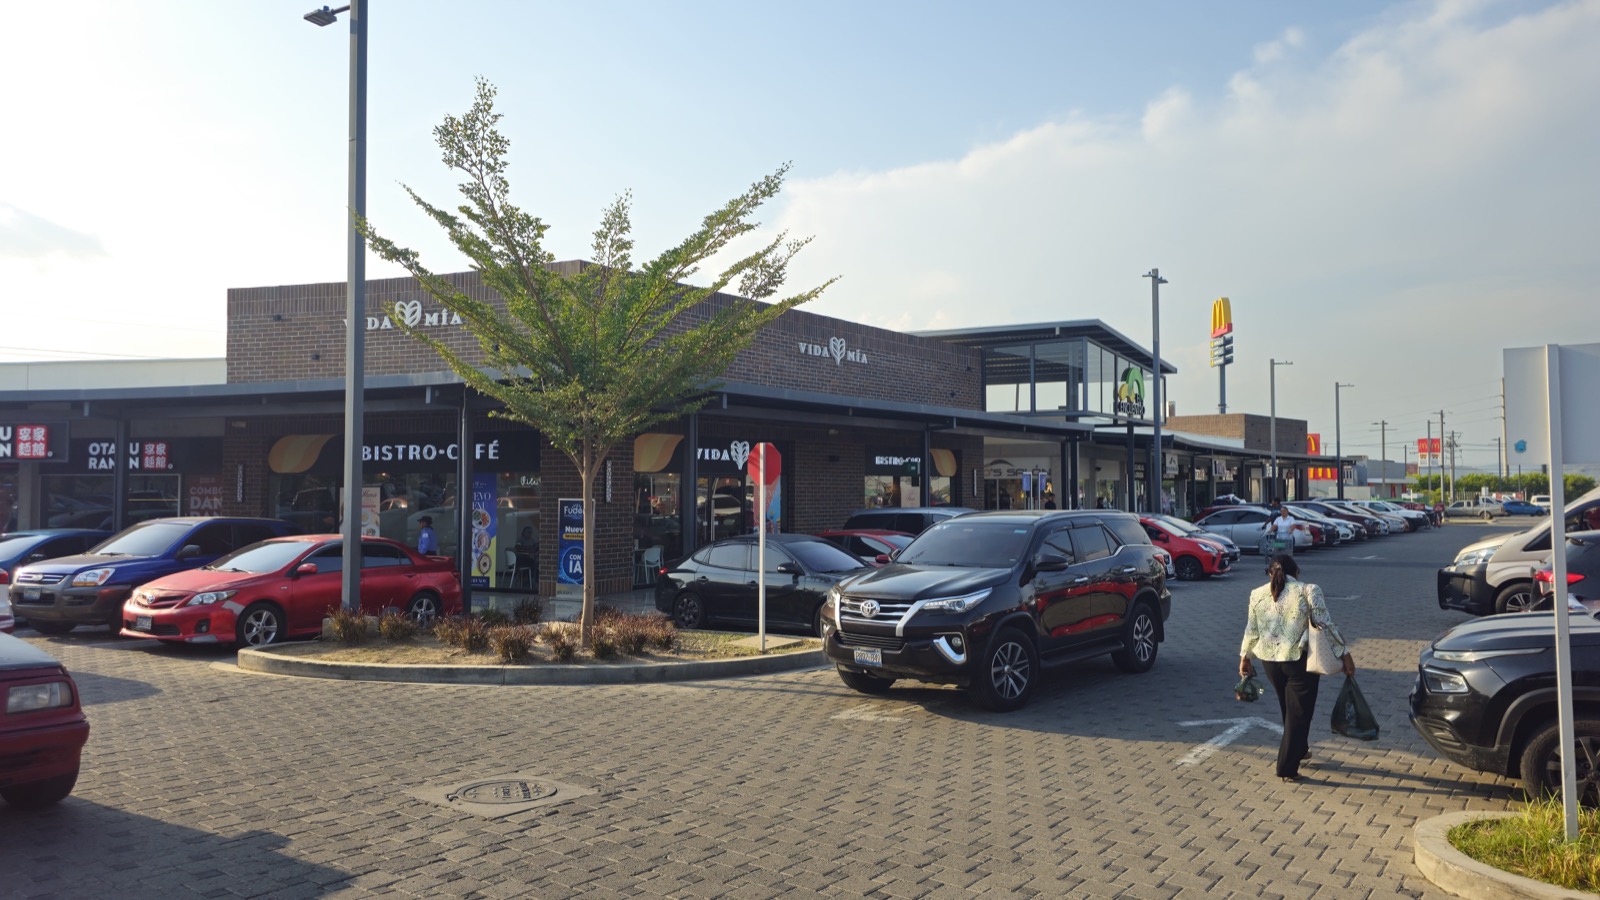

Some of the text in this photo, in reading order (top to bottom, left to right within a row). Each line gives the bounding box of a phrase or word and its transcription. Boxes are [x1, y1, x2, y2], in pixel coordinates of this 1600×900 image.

[343, 308, 463, 330] DA MÍA
[798, 342, 830, 358] VIDA
[88, 442, 140, 455] OTAU
[88, 456, 140, 469] RAMN
[189, 486, 223, 495] COMBO
[473, 492, 491, 501] EVO
[569, 561, 582, 574] IA
